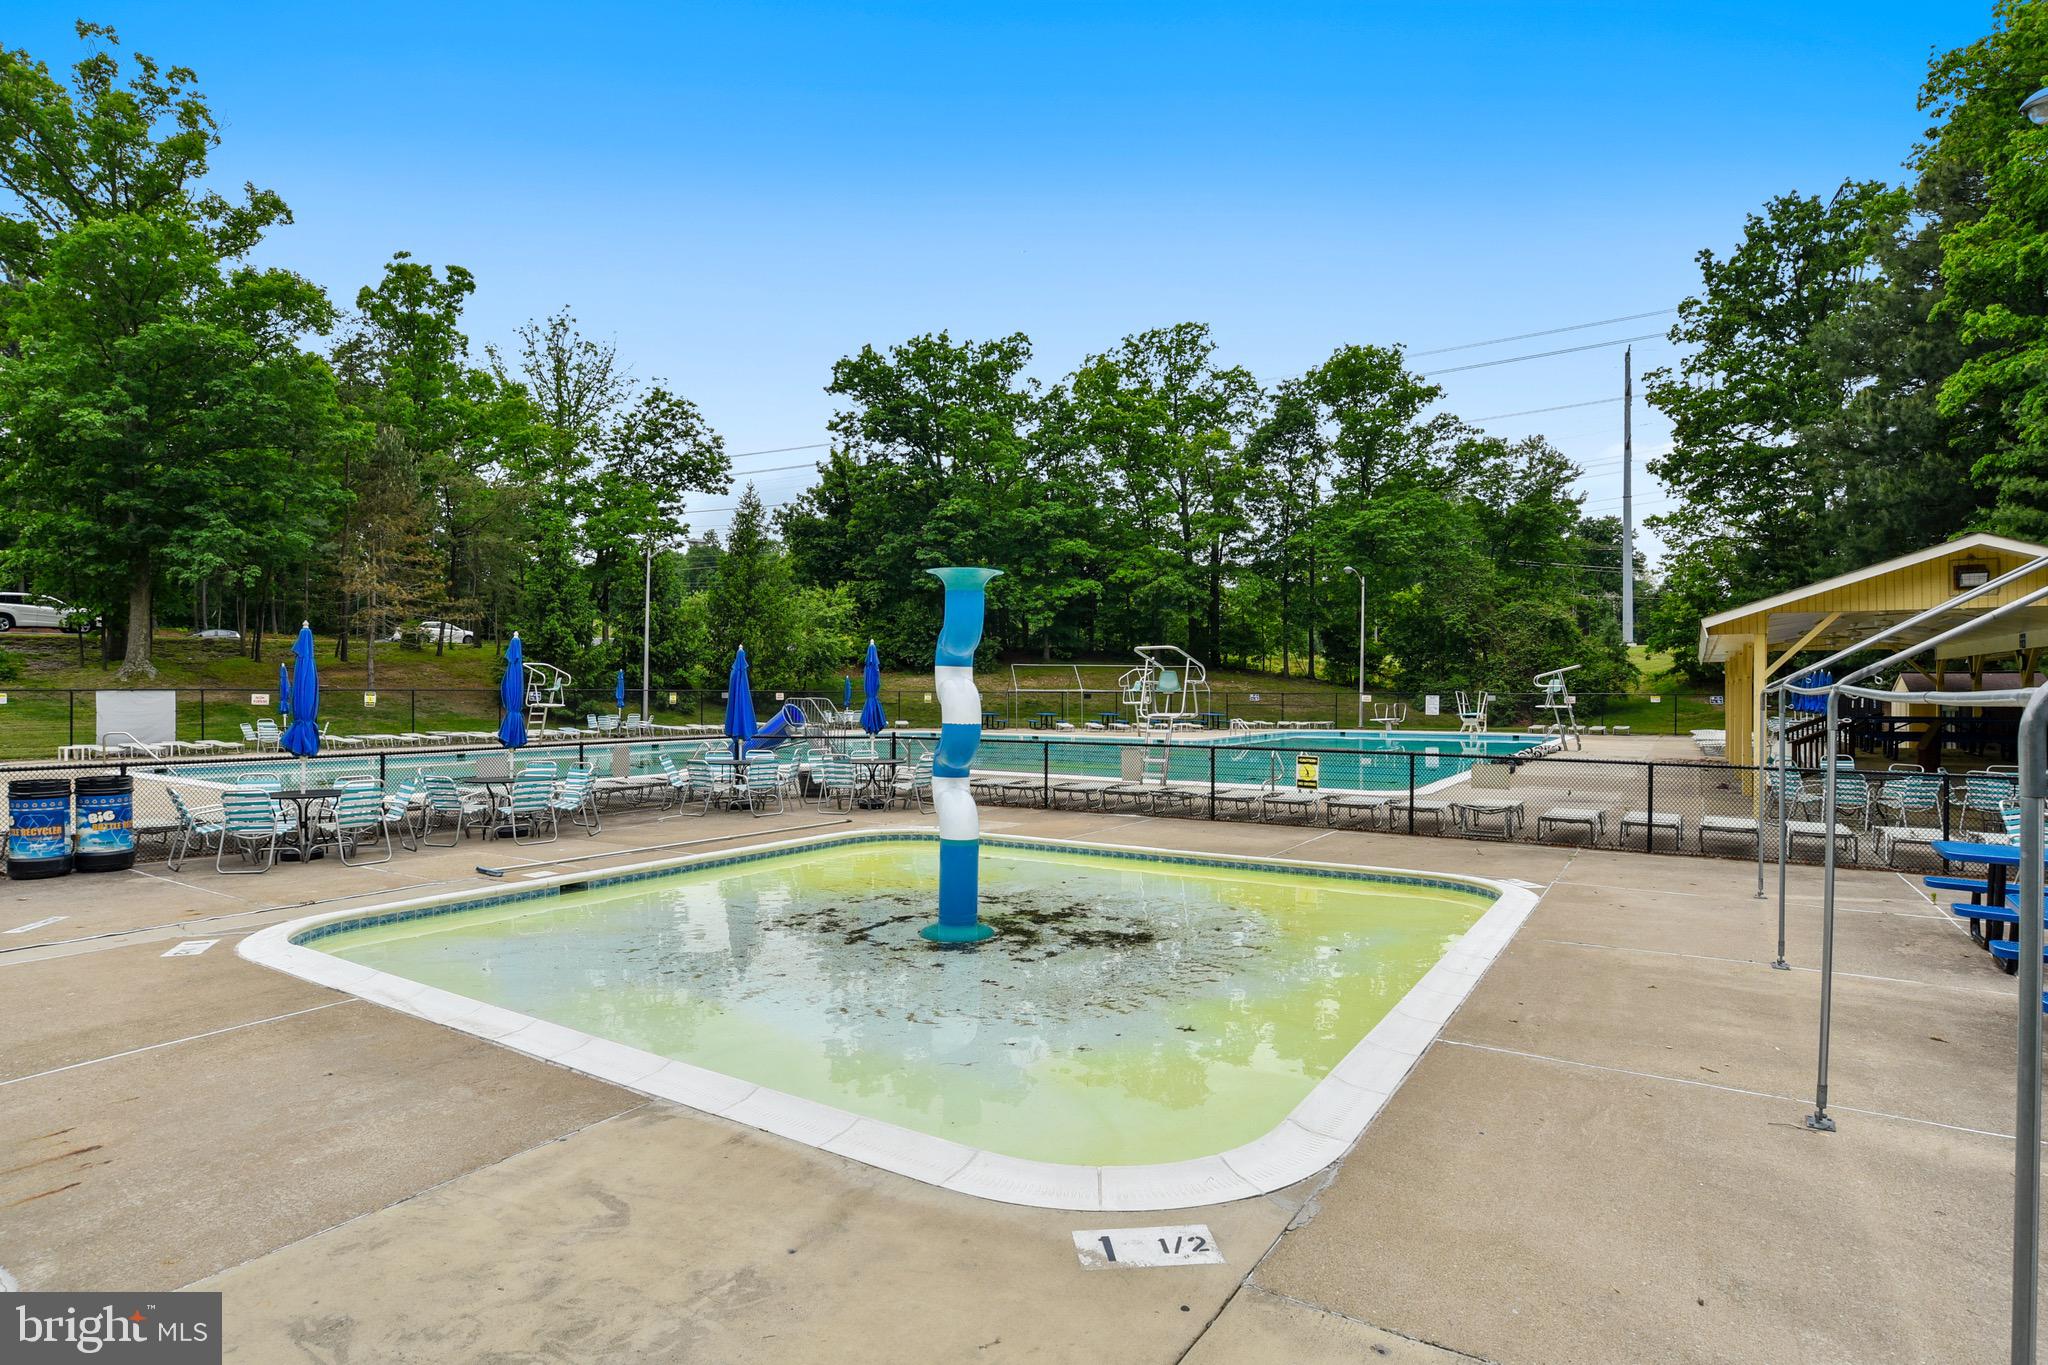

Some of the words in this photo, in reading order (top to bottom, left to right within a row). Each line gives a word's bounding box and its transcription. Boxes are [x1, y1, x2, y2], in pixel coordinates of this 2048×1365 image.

[20, 826, 62, 836] RECYCLER
[1098, 1235, 1117, 1262] 1
[1157, 1235, 1210, 1255] 1/2
